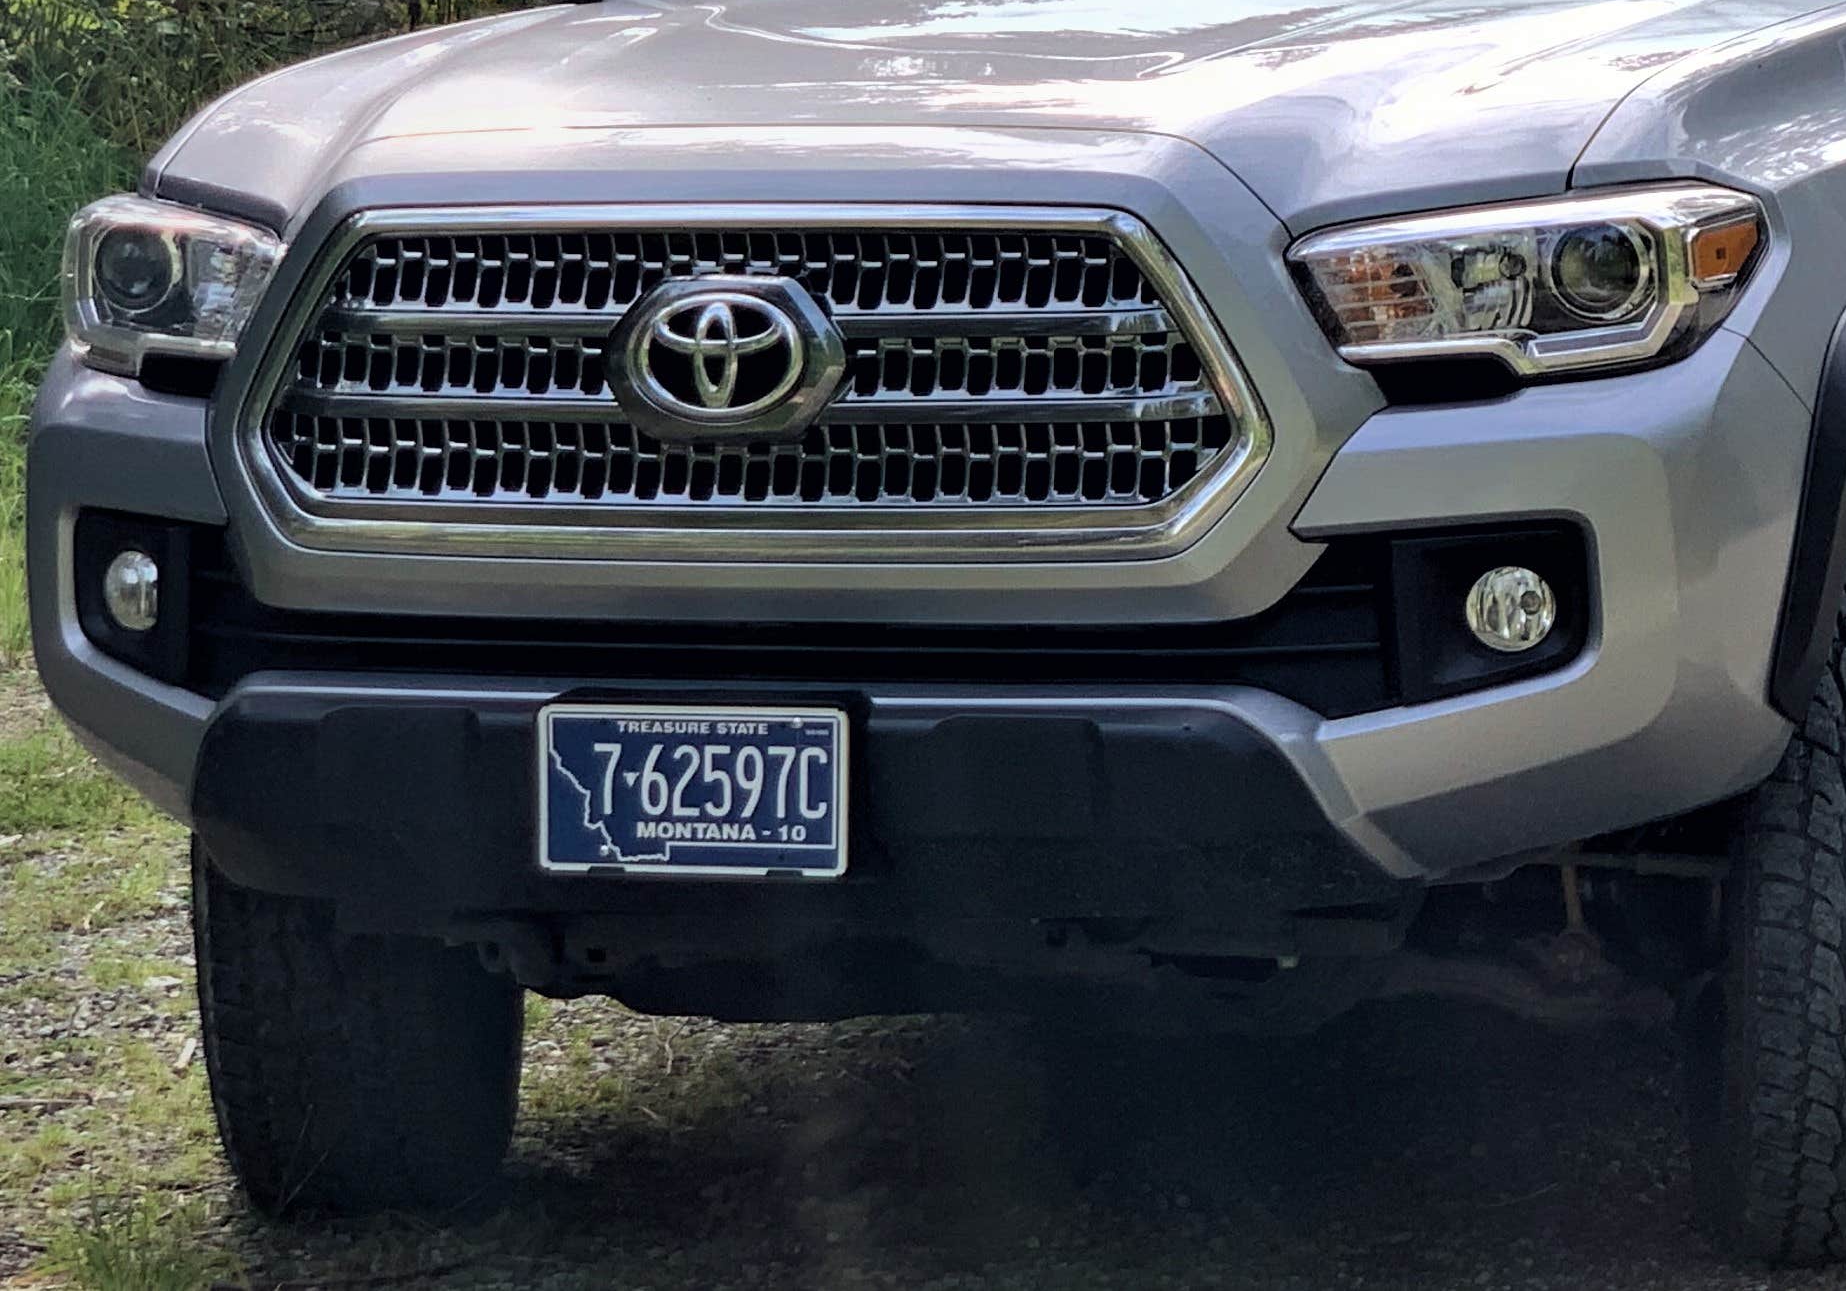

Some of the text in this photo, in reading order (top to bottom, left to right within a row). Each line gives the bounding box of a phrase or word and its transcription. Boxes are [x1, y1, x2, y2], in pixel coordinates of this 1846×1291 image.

[617, 720, 769, 735] TREASURE STATE
[636, 821, 757, 842] MONTANA
[780, 826, 807, 842] 10
